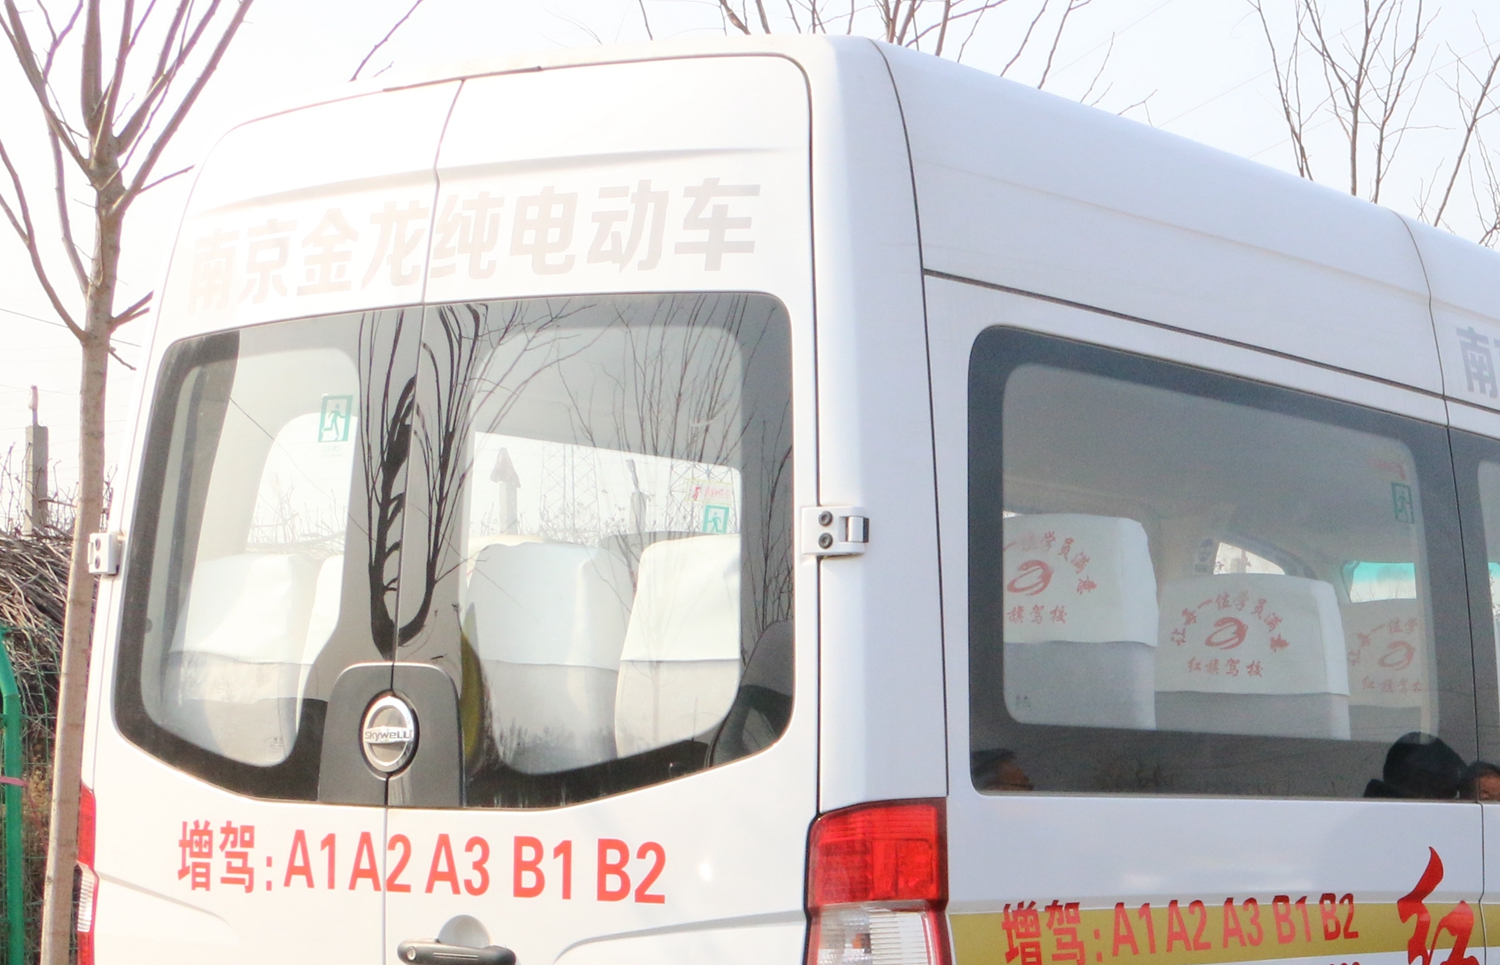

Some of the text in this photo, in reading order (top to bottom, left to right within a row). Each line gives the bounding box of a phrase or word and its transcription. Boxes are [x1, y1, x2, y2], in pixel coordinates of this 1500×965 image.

[187, 177, 760, 314] 南京金龙纯电动车
[424, 833, 490, 896] A3
[513, 835, 573, 900] B1
[596, 838, 666, 904] B2
[1222, 897, 1265, 948] A3
[1271, 895, 1312, 944] B1
[1318, 893, 1359, 941] B2
